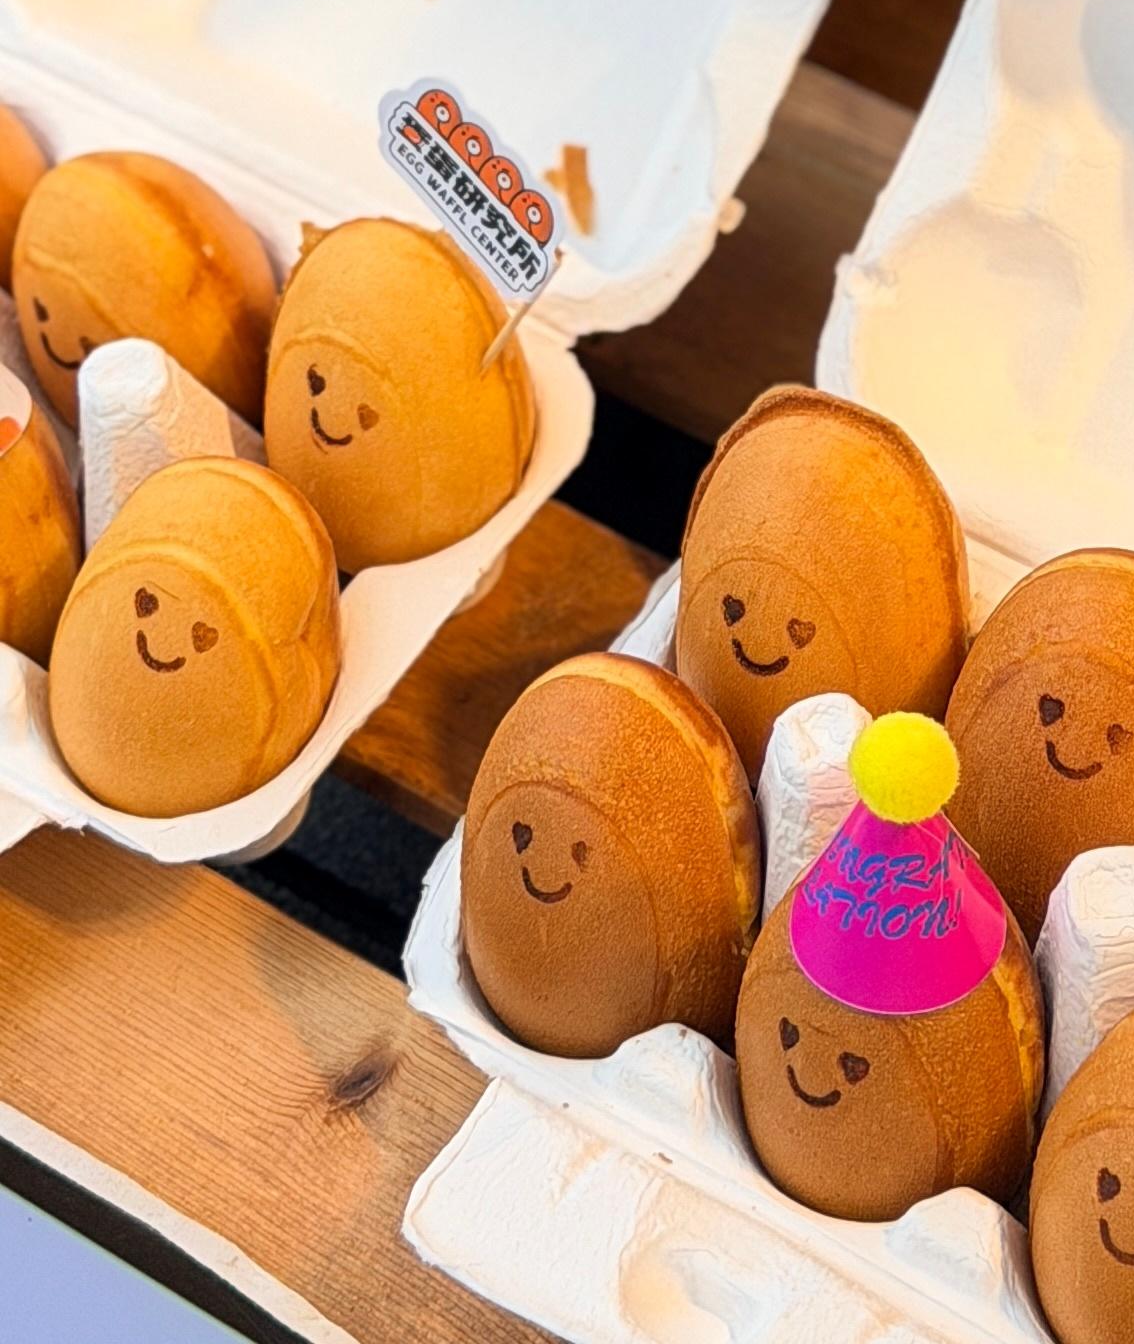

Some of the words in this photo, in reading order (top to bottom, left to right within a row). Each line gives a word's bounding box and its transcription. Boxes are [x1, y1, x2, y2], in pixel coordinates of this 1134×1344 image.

[396, 143, 424, 175] EGG
[427, 174, 467, 225] WAFFL
[470, 224, 519, 283] CENTER
